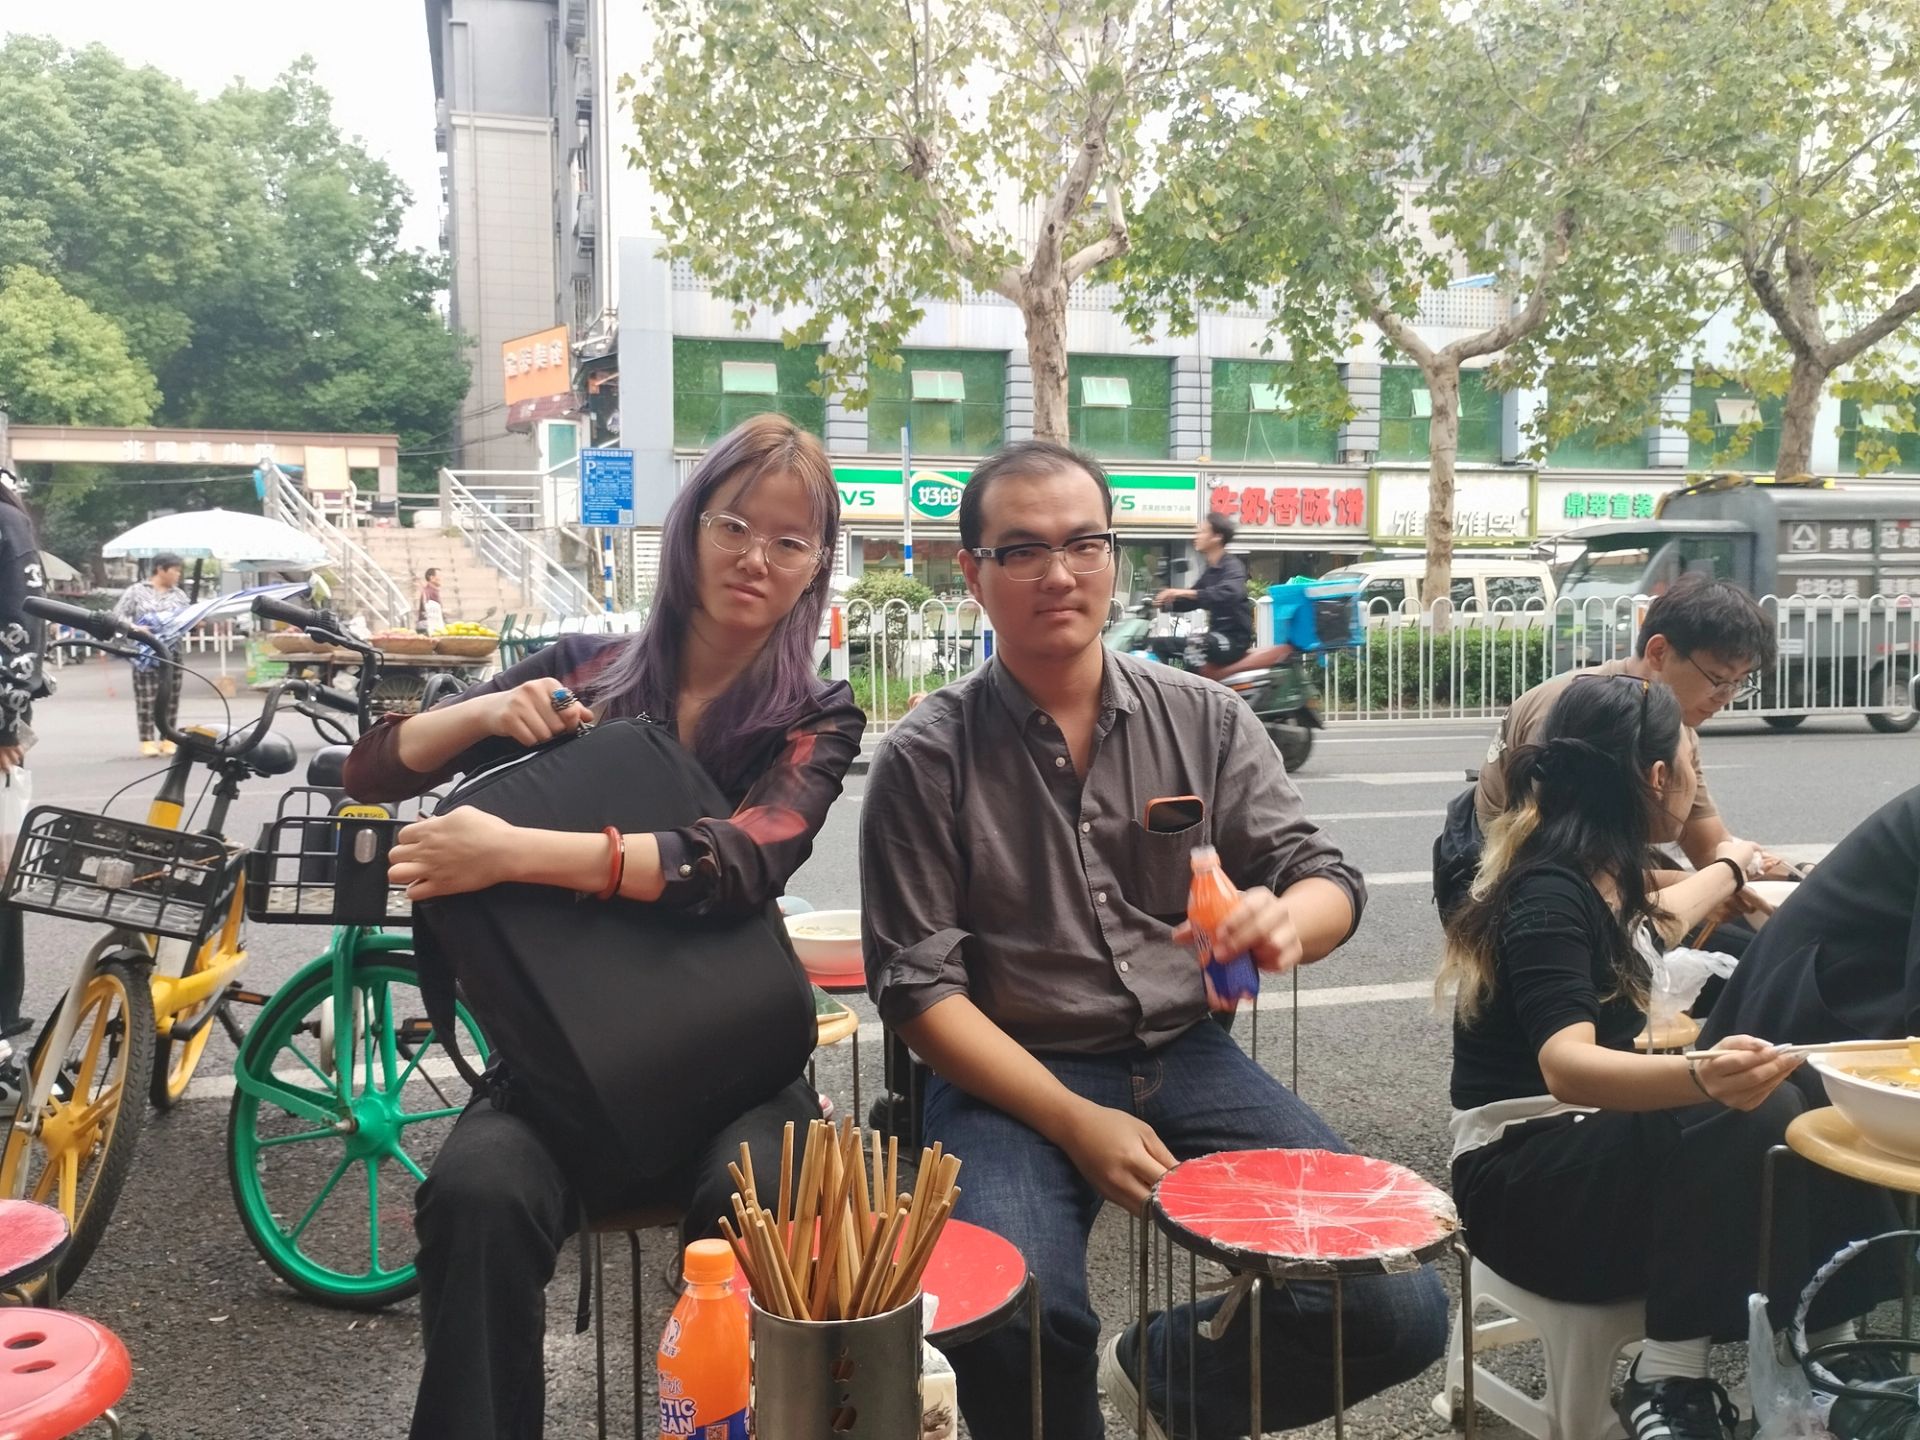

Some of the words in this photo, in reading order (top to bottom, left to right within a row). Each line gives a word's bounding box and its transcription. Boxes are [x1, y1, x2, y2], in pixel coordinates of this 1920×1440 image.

[1211, 486, 1364, 525] 牛奶香酥饼
